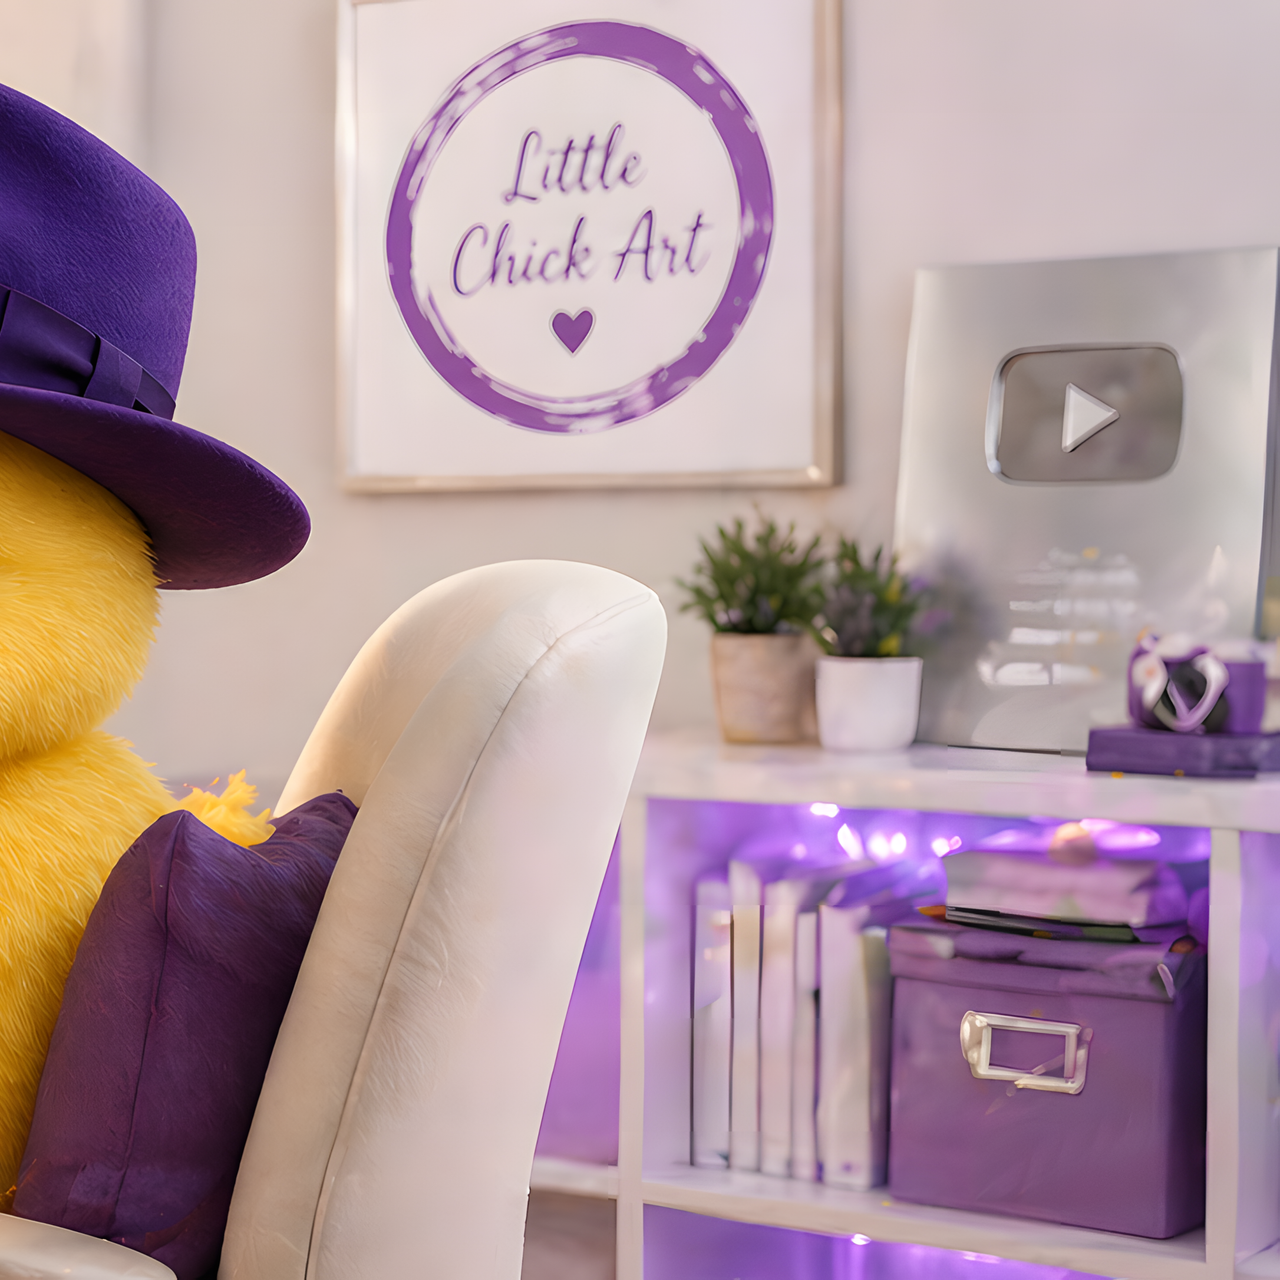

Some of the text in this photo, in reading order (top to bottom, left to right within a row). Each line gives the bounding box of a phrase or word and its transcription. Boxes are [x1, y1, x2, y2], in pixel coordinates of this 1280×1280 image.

[503, 123, 646, 204] Little
[452, 207, 712, 297] Chick Art
